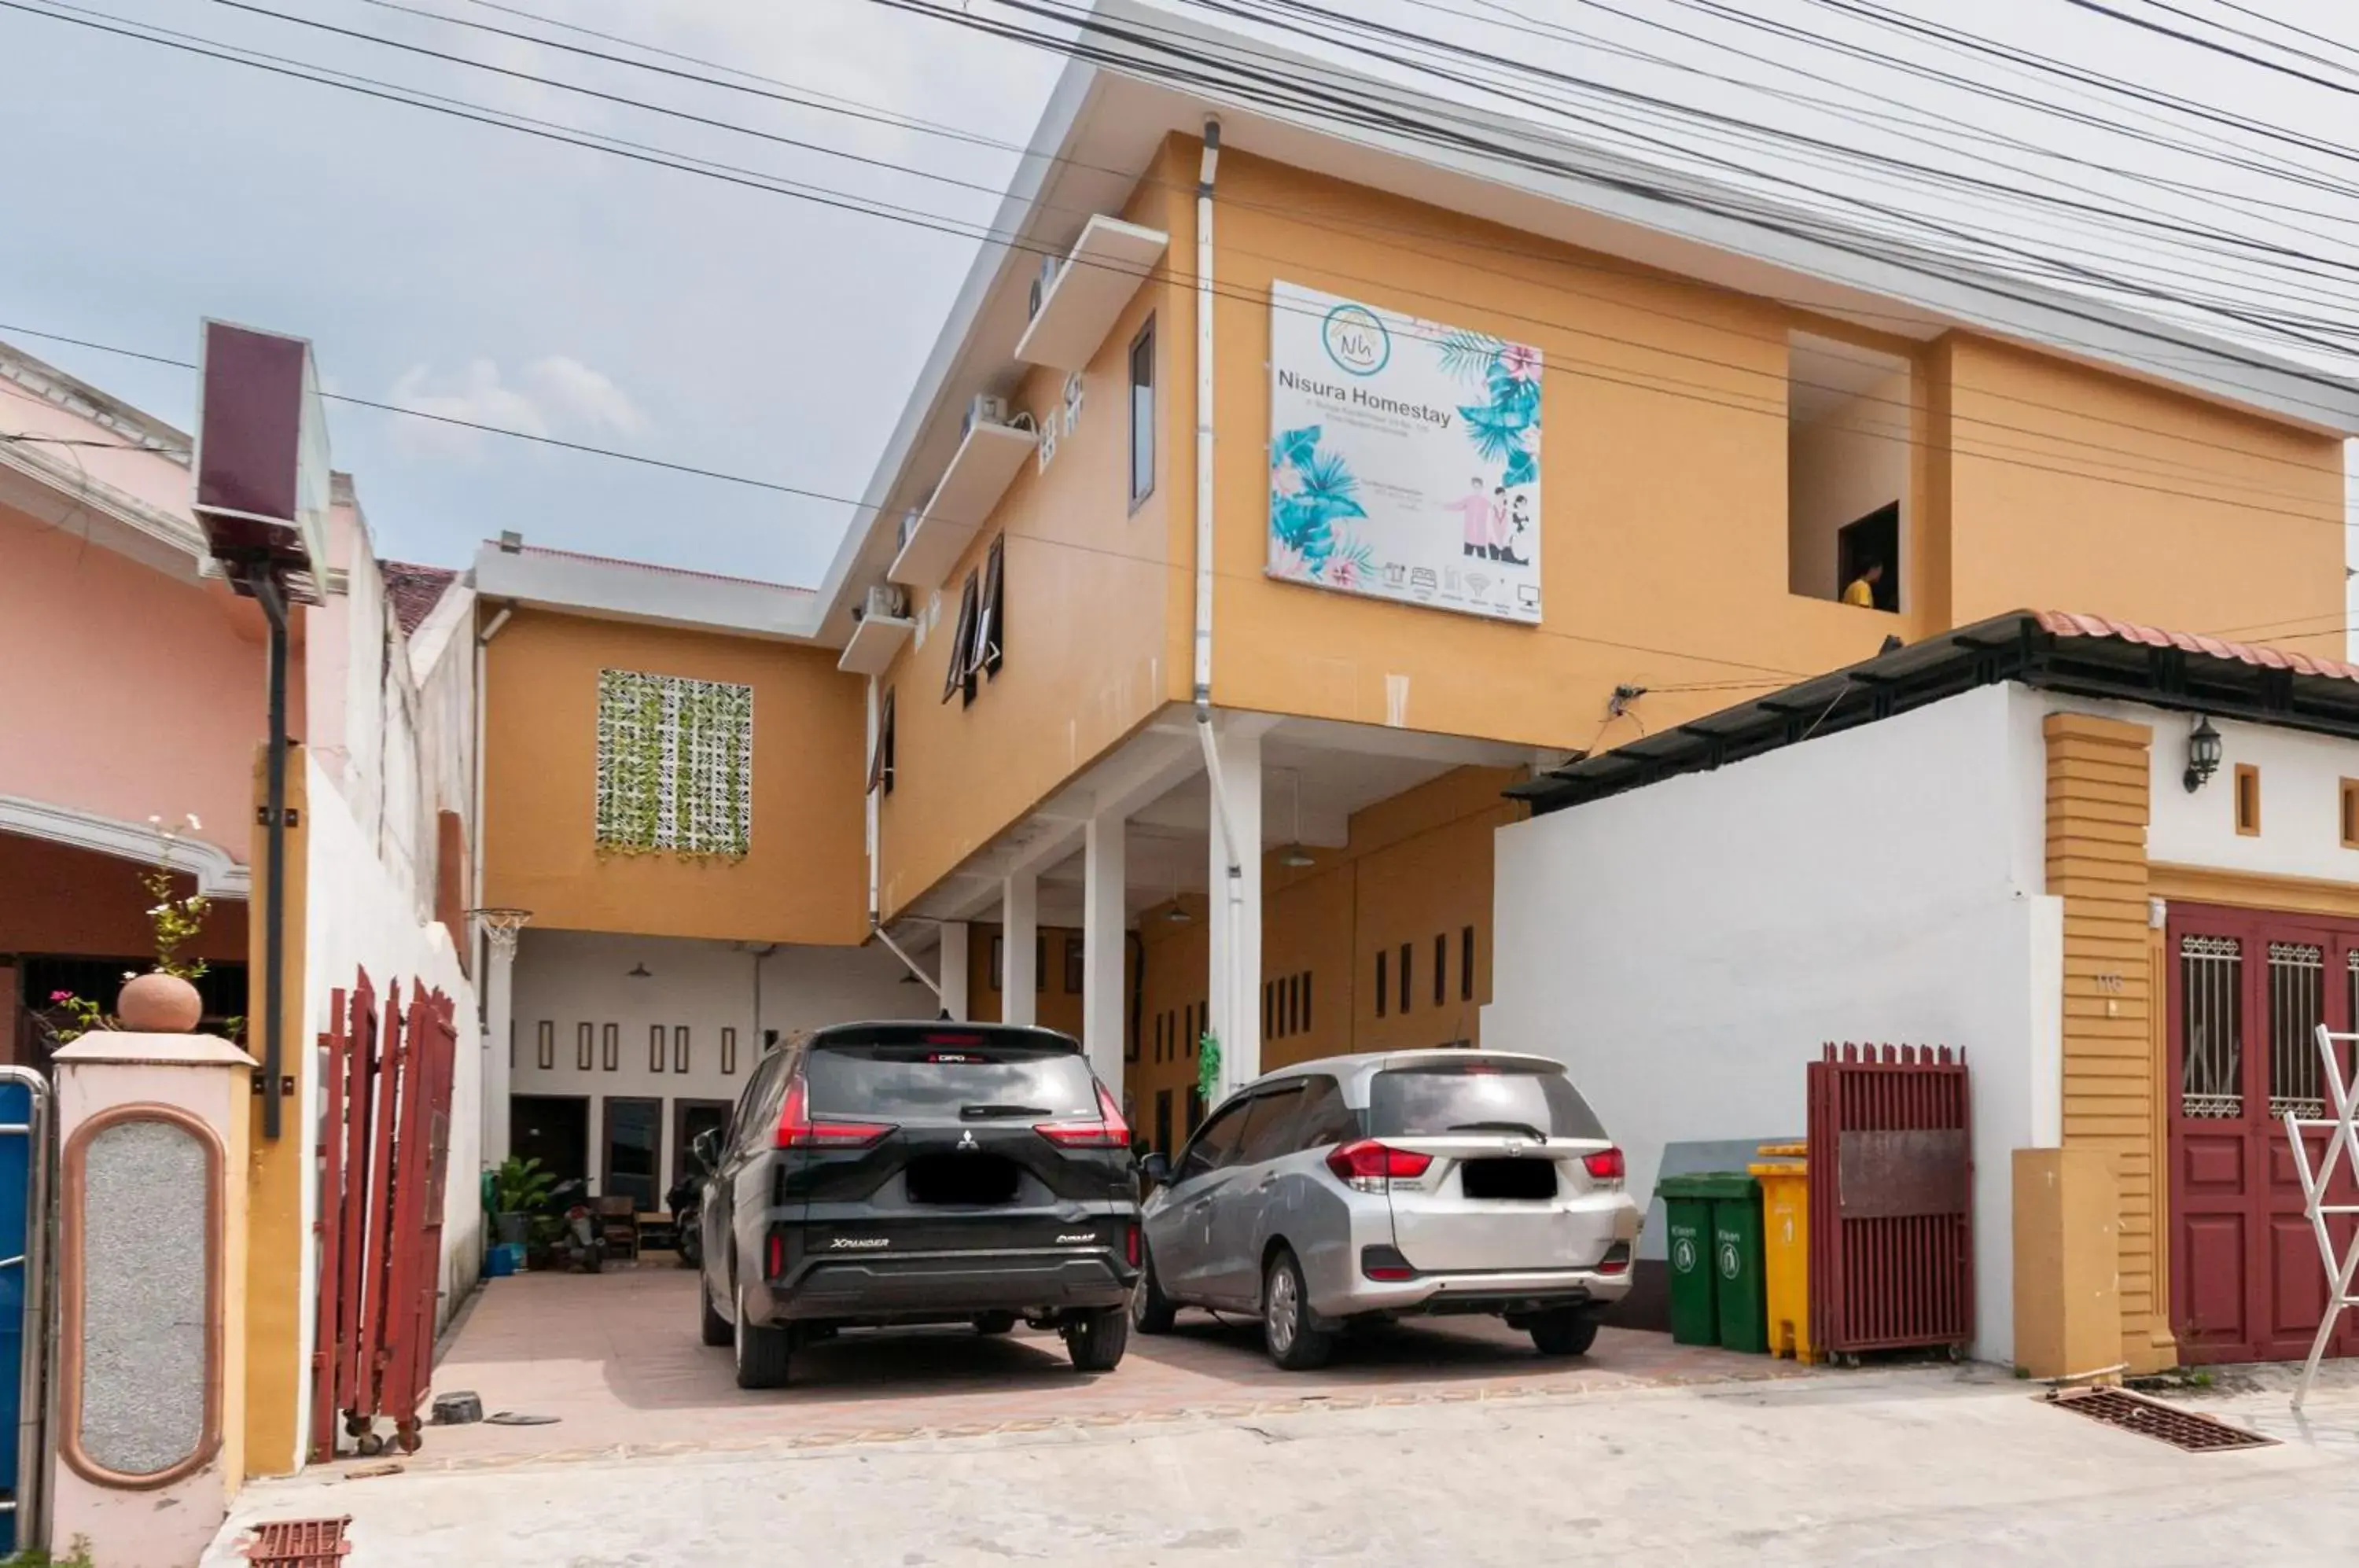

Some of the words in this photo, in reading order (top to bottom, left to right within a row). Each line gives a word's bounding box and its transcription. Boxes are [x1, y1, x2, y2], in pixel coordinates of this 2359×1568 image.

[1279, 370, 1345, 401] Nisura
[1352, 386, 1452, 429] Homestay
[830, 1238, 889, 1249] XPANDER
